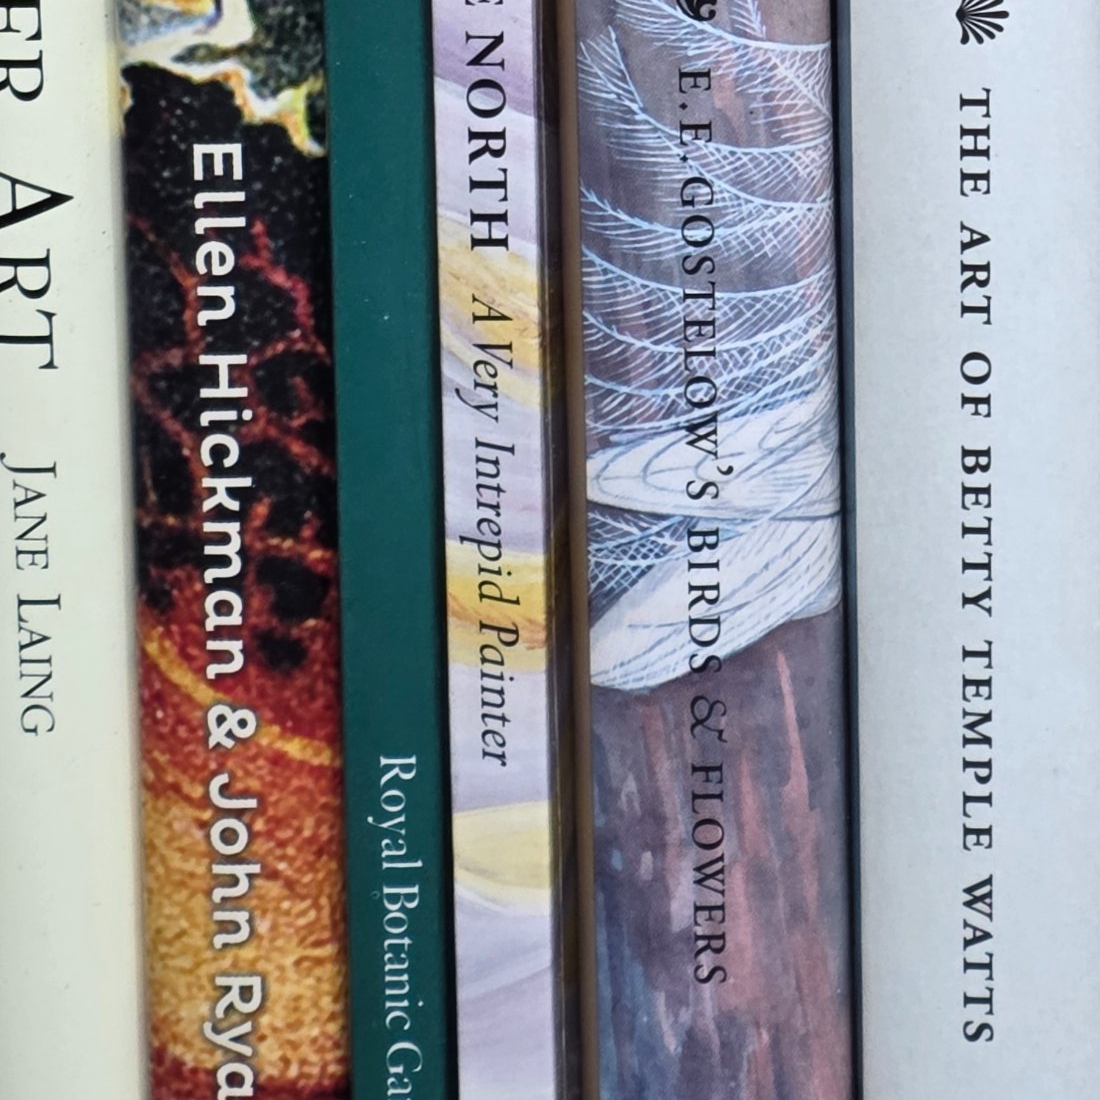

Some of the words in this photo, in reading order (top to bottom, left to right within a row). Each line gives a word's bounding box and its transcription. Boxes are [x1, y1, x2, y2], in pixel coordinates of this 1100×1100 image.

[463, 30, 511, 252] NORTH
[958, 86, 993, 199] THE
[0, 170, 76, 372] ART
[191, 142, 246, 327] Ellen
[469, 293, 503, 325] A
[958, 220, 994, 326] ART
[453, 338, 515, 427] Very
[958, 350, 994, 419] OF
[0, 448, 58, 572] JANE
[197, 353, 253, 680] Hickman
[458, 436, 522, 606] Intrepid
[960, 444, 996, 618] BETTY
[14, 592, 63, 737] LAING
[685, 525, 722, 675] BIRDS
[205, 702, 258, 750] &
[477, 618, 522, 768] Painter
[688, 694, 728, 744] &
[960, 638, 996, 853] TEMPLE
[207, 772, 262, 948] John
[366, 754, 424, 872] Royal
[689, 761, 729, 986] FLOWERS
[378, 882, 426, 1032] Botanic
[960, 872, 996, 1044] WATTS
[202, 974, 264, 1100] Rya
[384, 1040, 424, 1100] Ga
